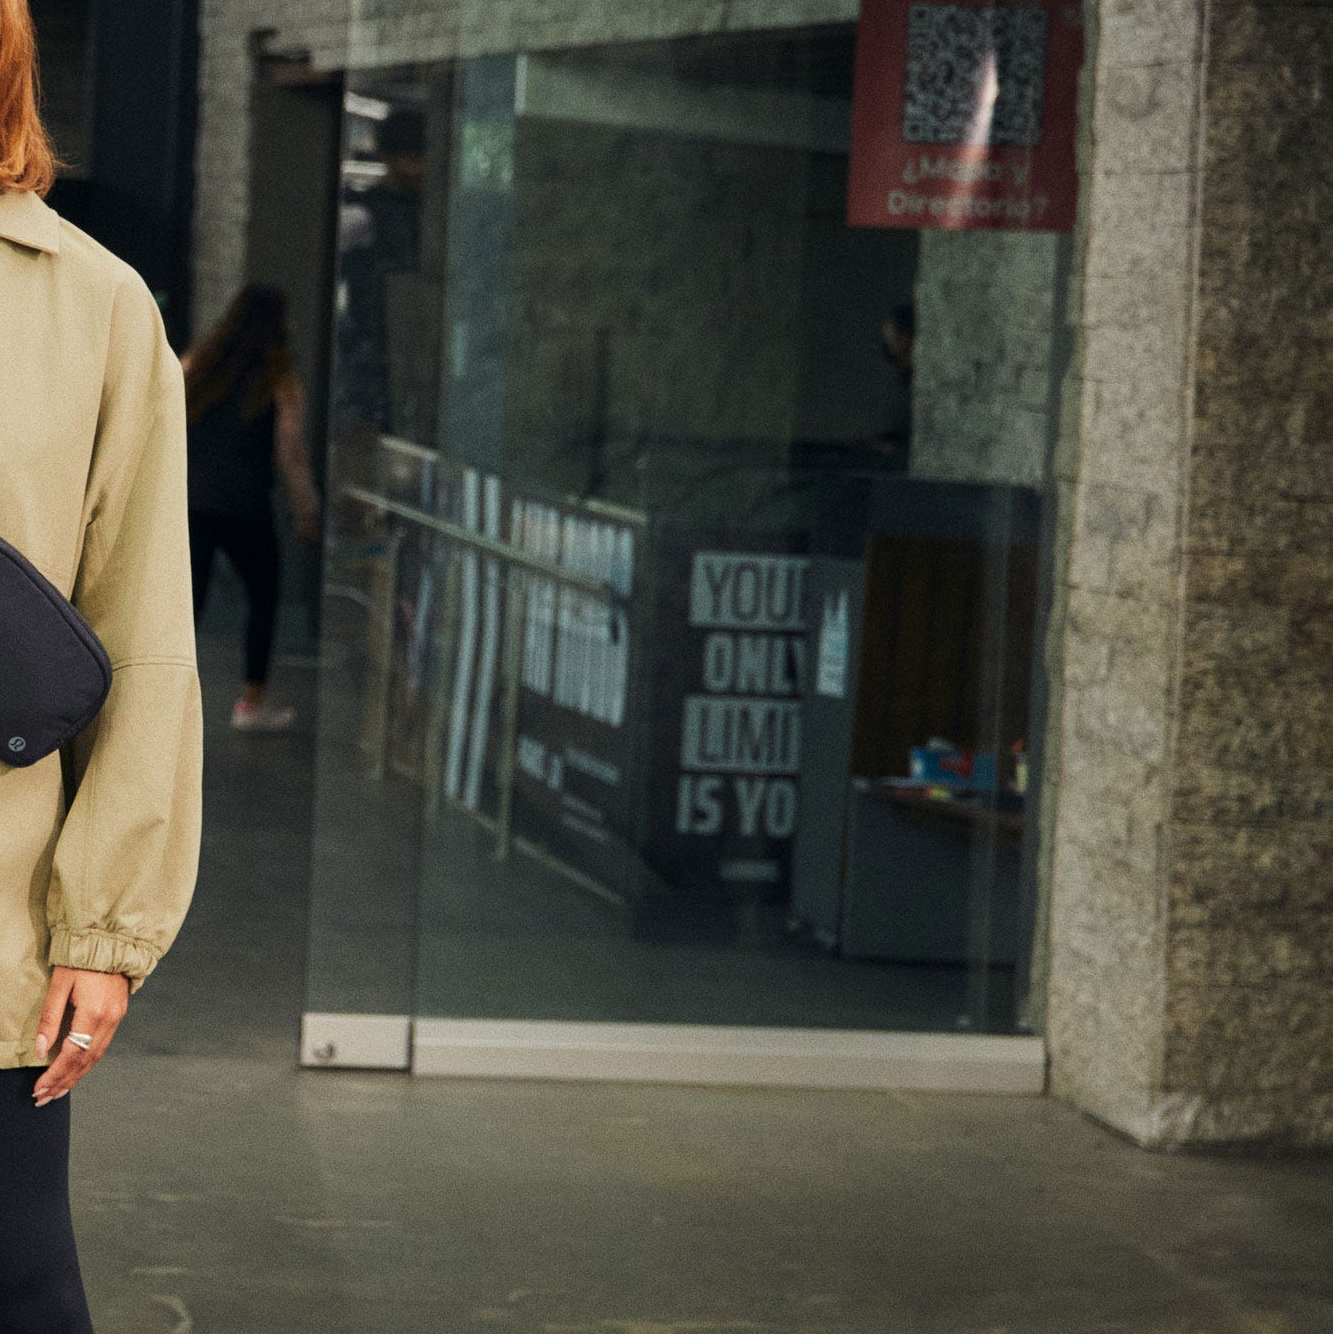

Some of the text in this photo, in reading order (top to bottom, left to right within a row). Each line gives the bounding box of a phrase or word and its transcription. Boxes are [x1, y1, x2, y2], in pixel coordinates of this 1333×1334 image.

[703, 560, 808, 624] YOU
[697, 706, 801, 766] LIMI
[676, 774, 723, 835] IS
